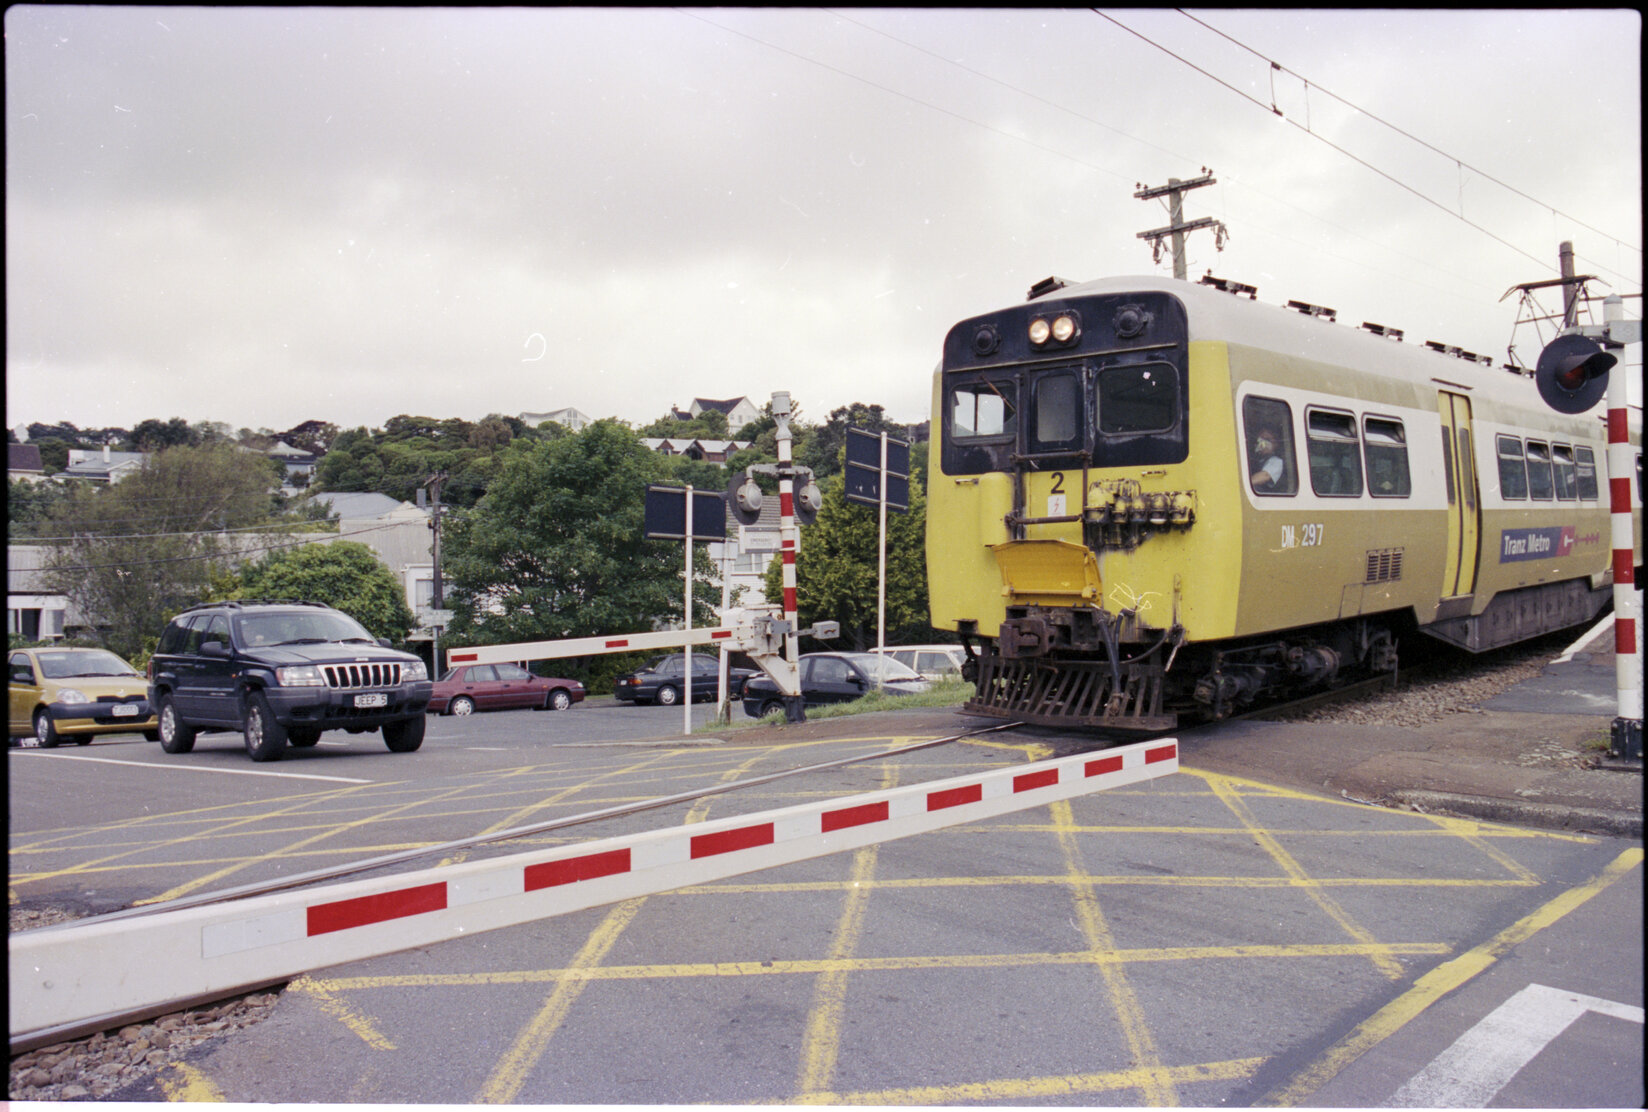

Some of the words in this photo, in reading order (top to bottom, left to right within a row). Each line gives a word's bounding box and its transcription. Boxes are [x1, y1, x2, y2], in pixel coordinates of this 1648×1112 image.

[1051, 471, 1065, 494] 2
[1281, 525, 1295, 548] DM
[1301, 523, 1324, 547] 297
[1504, 535, 1527, 556] Tranz
[1527, 533, 1551, 553] Metro
[355, 695, 377, 706] JEEP
